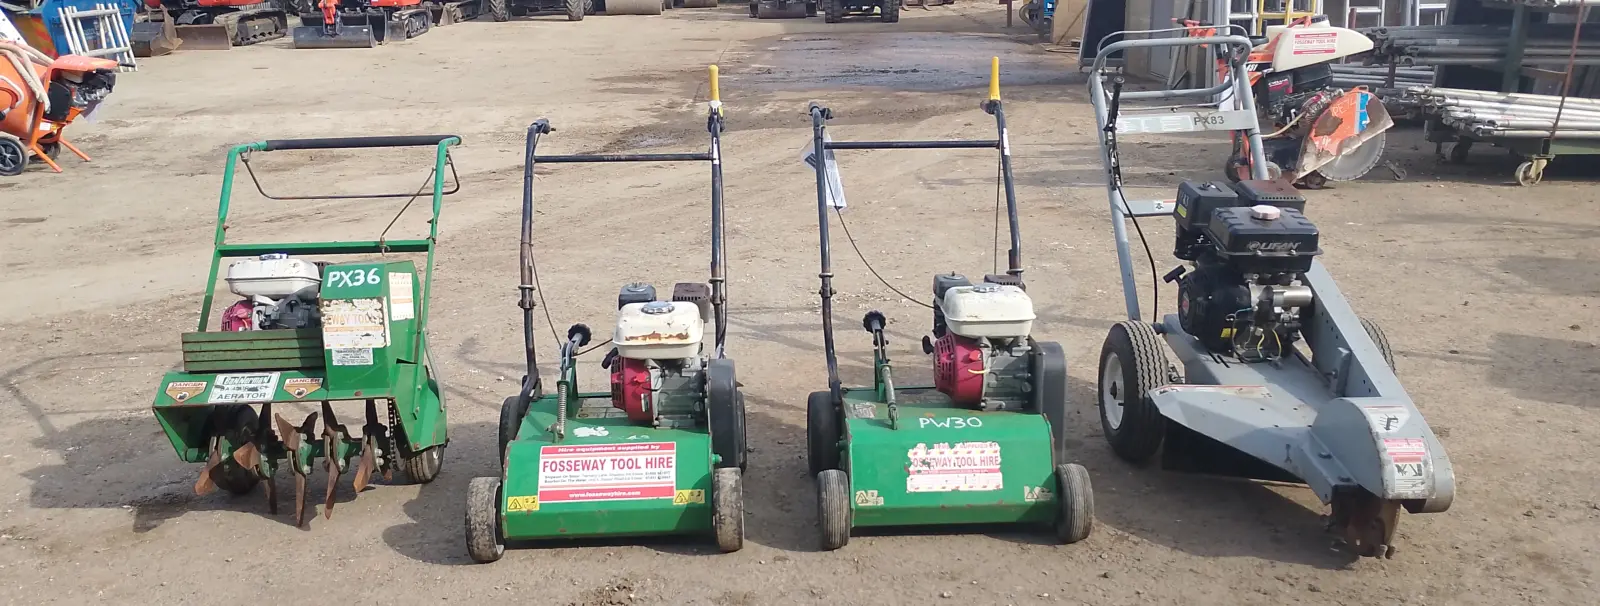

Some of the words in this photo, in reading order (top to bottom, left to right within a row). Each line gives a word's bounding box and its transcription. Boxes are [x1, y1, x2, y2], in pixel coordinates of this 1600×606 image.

[1193, 115, 1225, 126] PX83
[1261, 241, 1298, 251] LIFAN
[327, 267, 381, 288] PX36
[289, 377, 321, 385] DANGER
[216, 392, 267, 400] AERATOR
[918, 416, 983, 429] PW30
[617, 444, 649, 452] supplied
[542, 458, 607, 473] FOSSEWAY
[610, 457, 642, 471] TOOL
[645, 456, 673, 469] HIRE
[912, 455, 952, 469] OSSEWAY
[954, 456, 978, 468] TOOL
[979, 455, 999, 467] HIRE
[568, 489, 642, 498] www.fossewayhire.com
